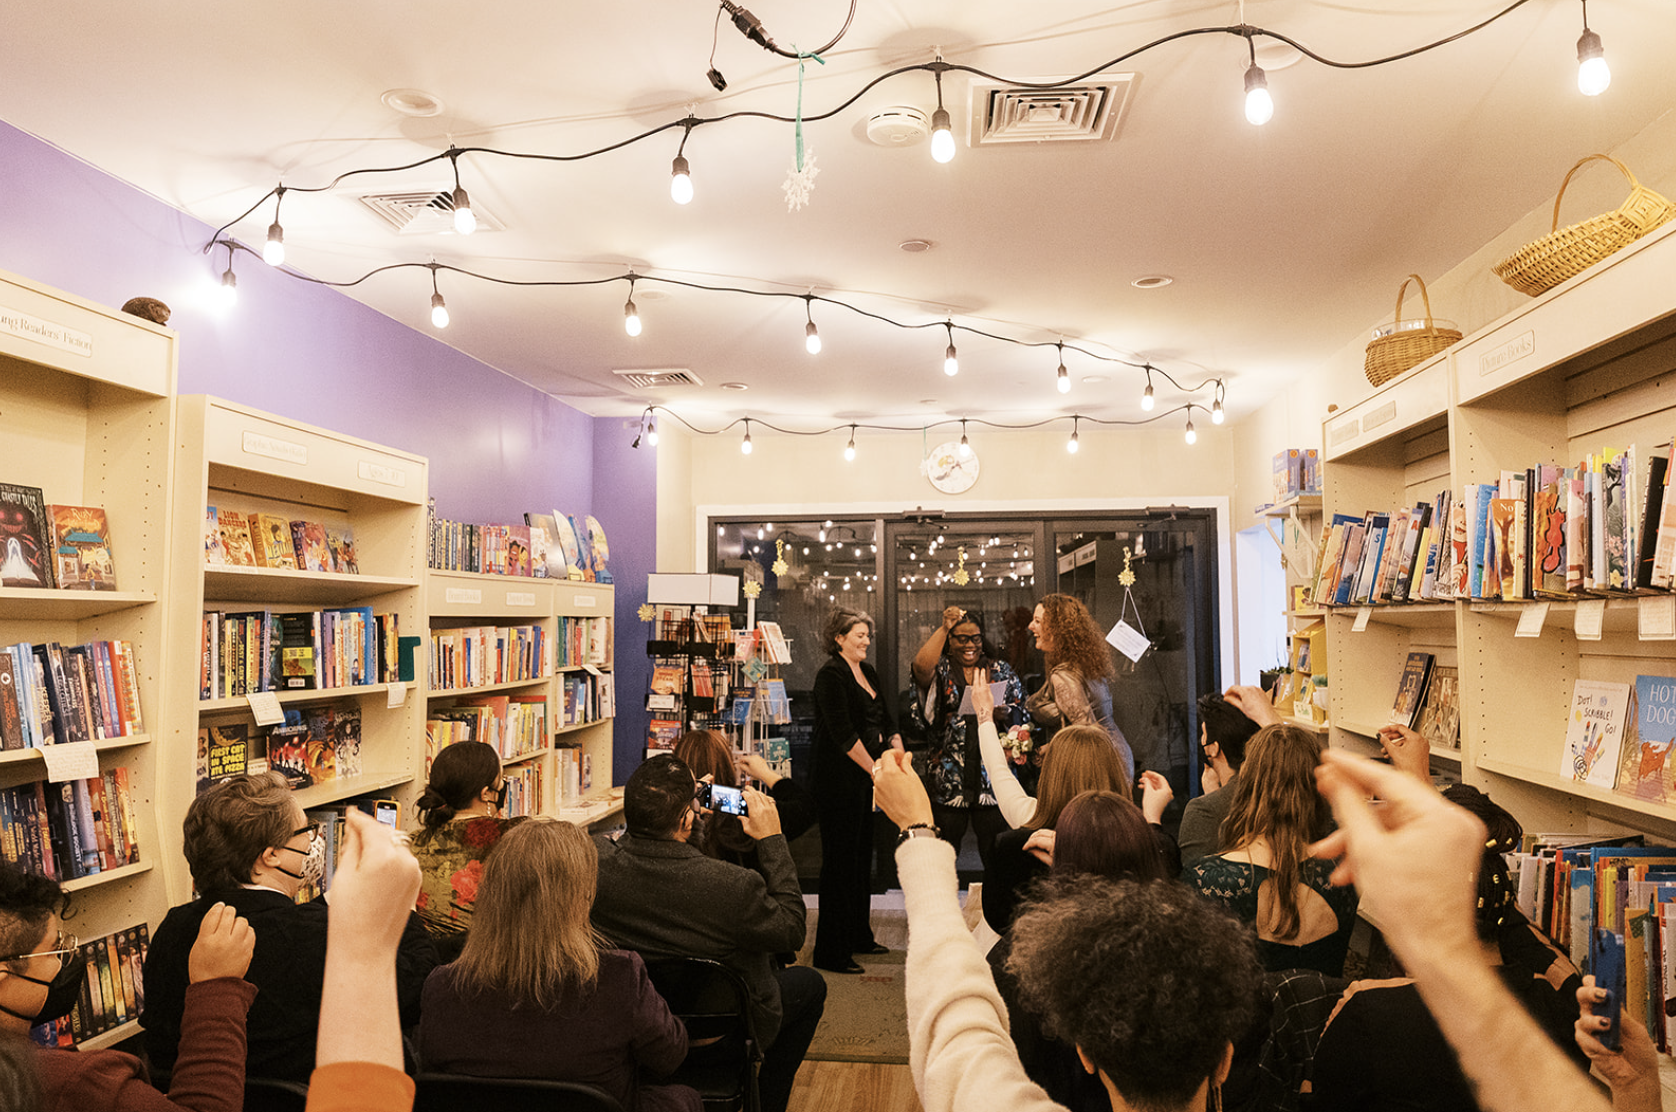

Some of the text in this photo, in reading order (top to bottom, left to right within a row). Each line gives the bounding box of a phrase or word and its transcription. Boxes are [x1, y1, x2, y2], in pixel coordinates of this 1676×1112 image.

[63, 332, 92, 351] Fiction
[1507, 337, 1532, 359] Books
[1650, 684, 1676, 704] HOT
[211, 743, 245, 759] FIRST CAT
[222, 753, 245, 766] SPACE
[225, 762, 245, 774] PIZZA
